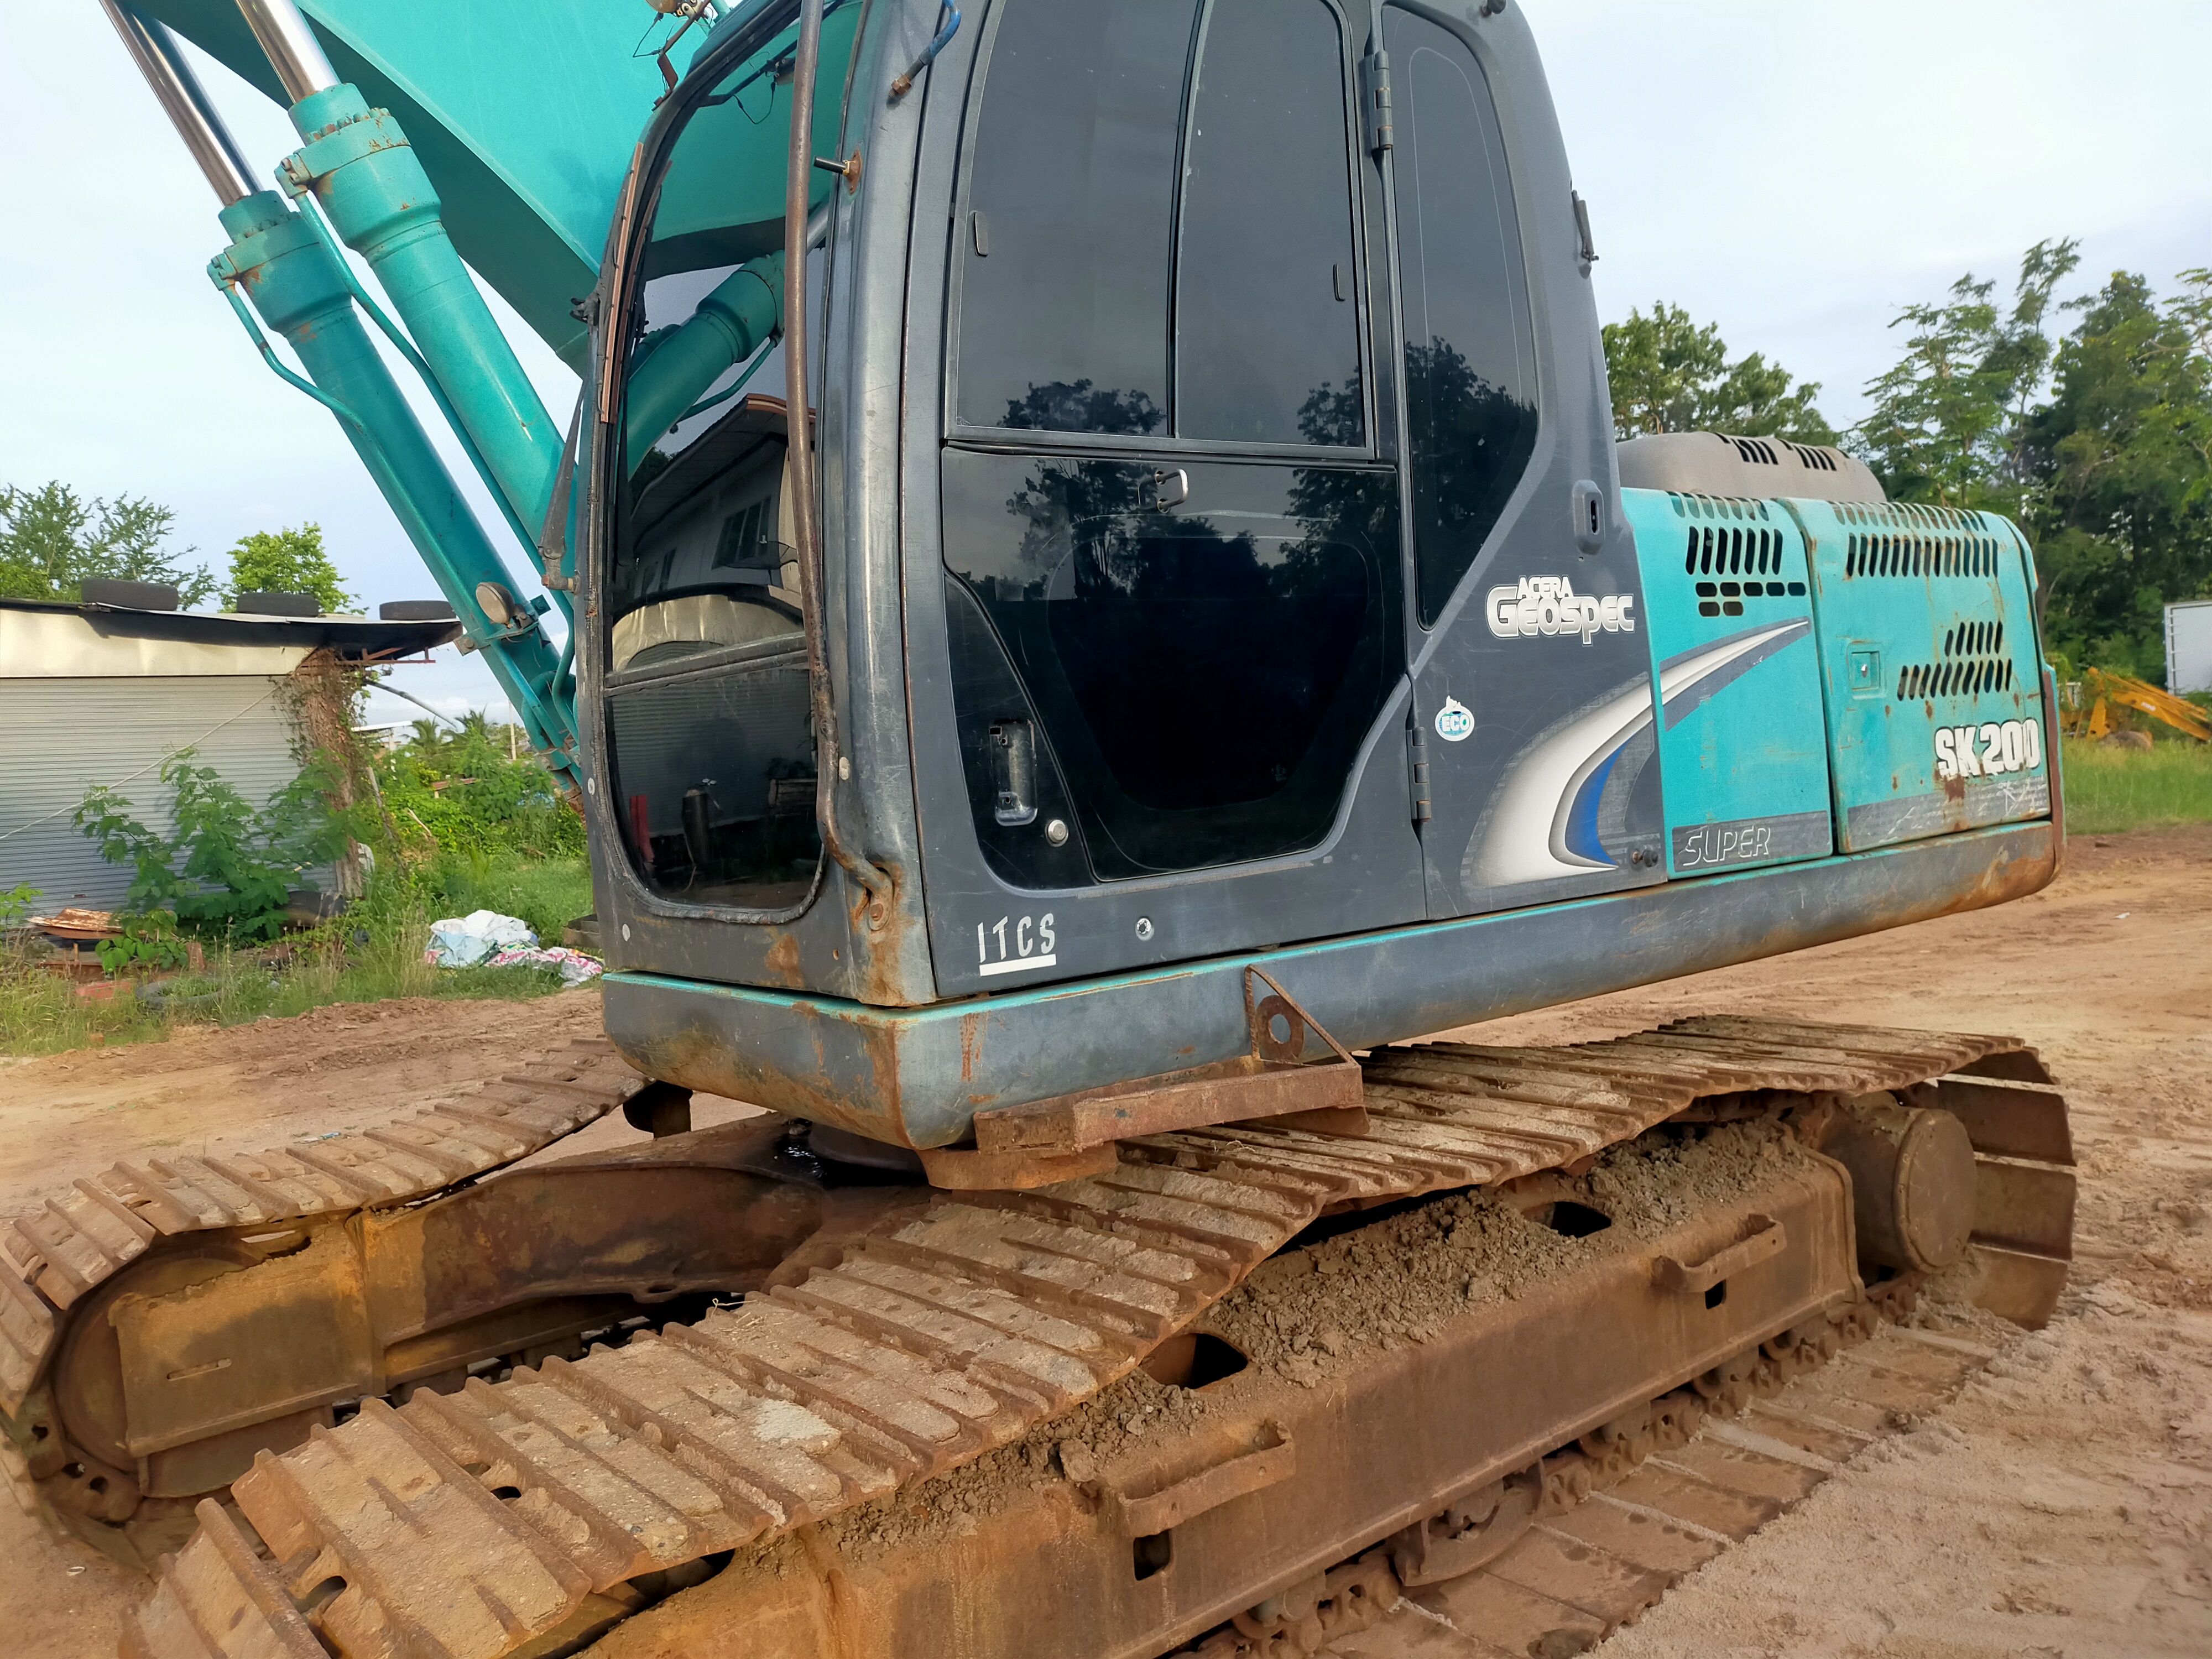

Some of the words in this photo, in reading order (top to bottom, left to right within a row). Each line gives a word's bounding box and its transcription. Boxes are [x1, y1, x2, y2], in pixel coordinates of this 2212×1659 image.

[1516, 576, 1574, 599] ACERA
[1442, 714, 1470, 732] ECO
[1683, 826, 1771, 866] SUPER
[977, 912, 1056, 963] ITCS
